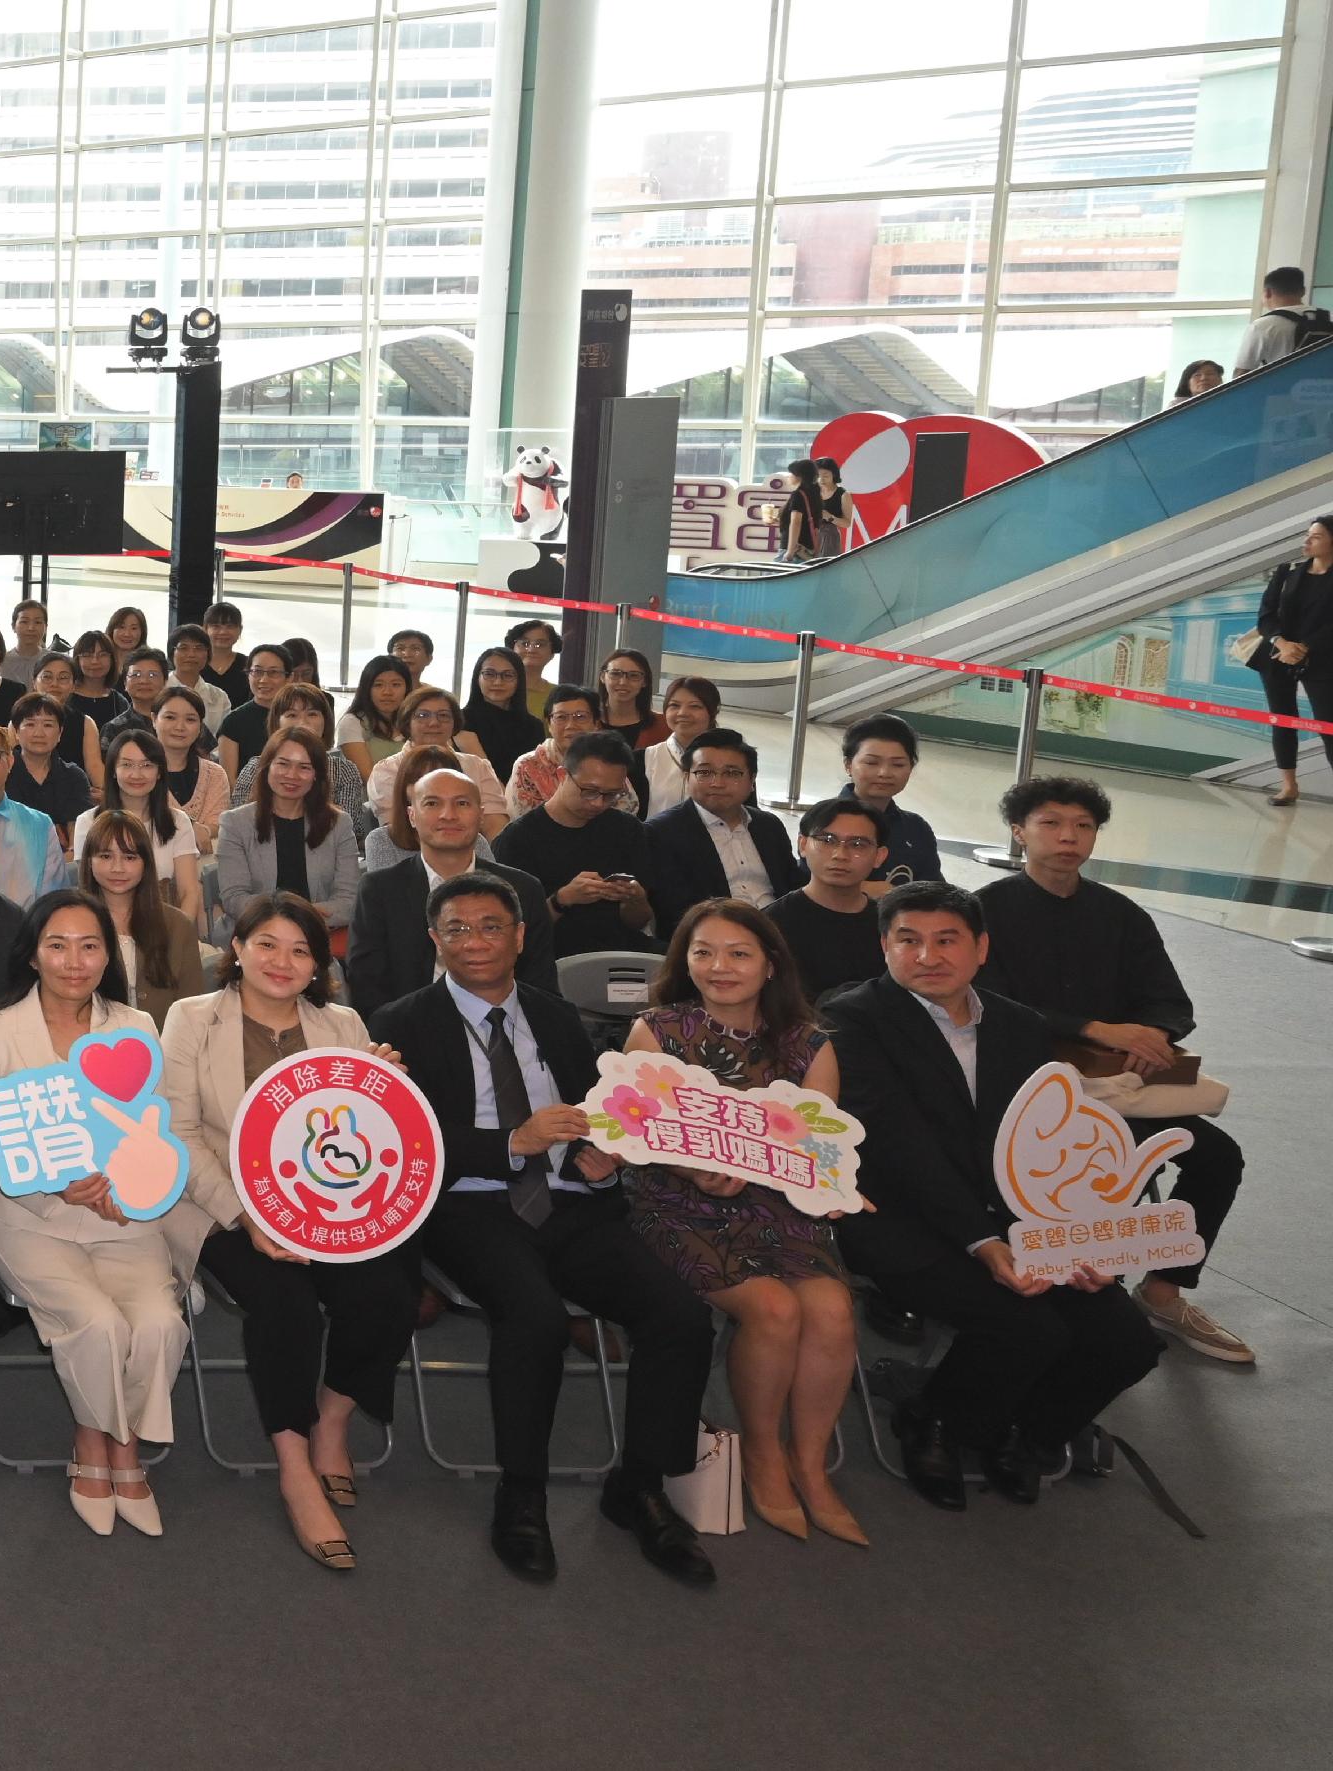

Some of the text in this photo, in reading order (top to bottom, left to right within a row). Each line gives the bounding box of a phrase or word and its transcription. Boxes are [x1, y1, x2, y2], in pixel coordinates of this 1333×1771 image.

[262, 1060, 392, 1112] 消除差距
[673, 1086, 768, 1136] 支持
[641, 1116, 815, 1189] 授乳媽媽
[253, 1158, 429, 1246] 為所有人提供母乳哺育支持
[1021, 1211, 1187, 1252] 愛嬰母嬰健康院
[1147, 1243, 1197, 1260] MCHC
